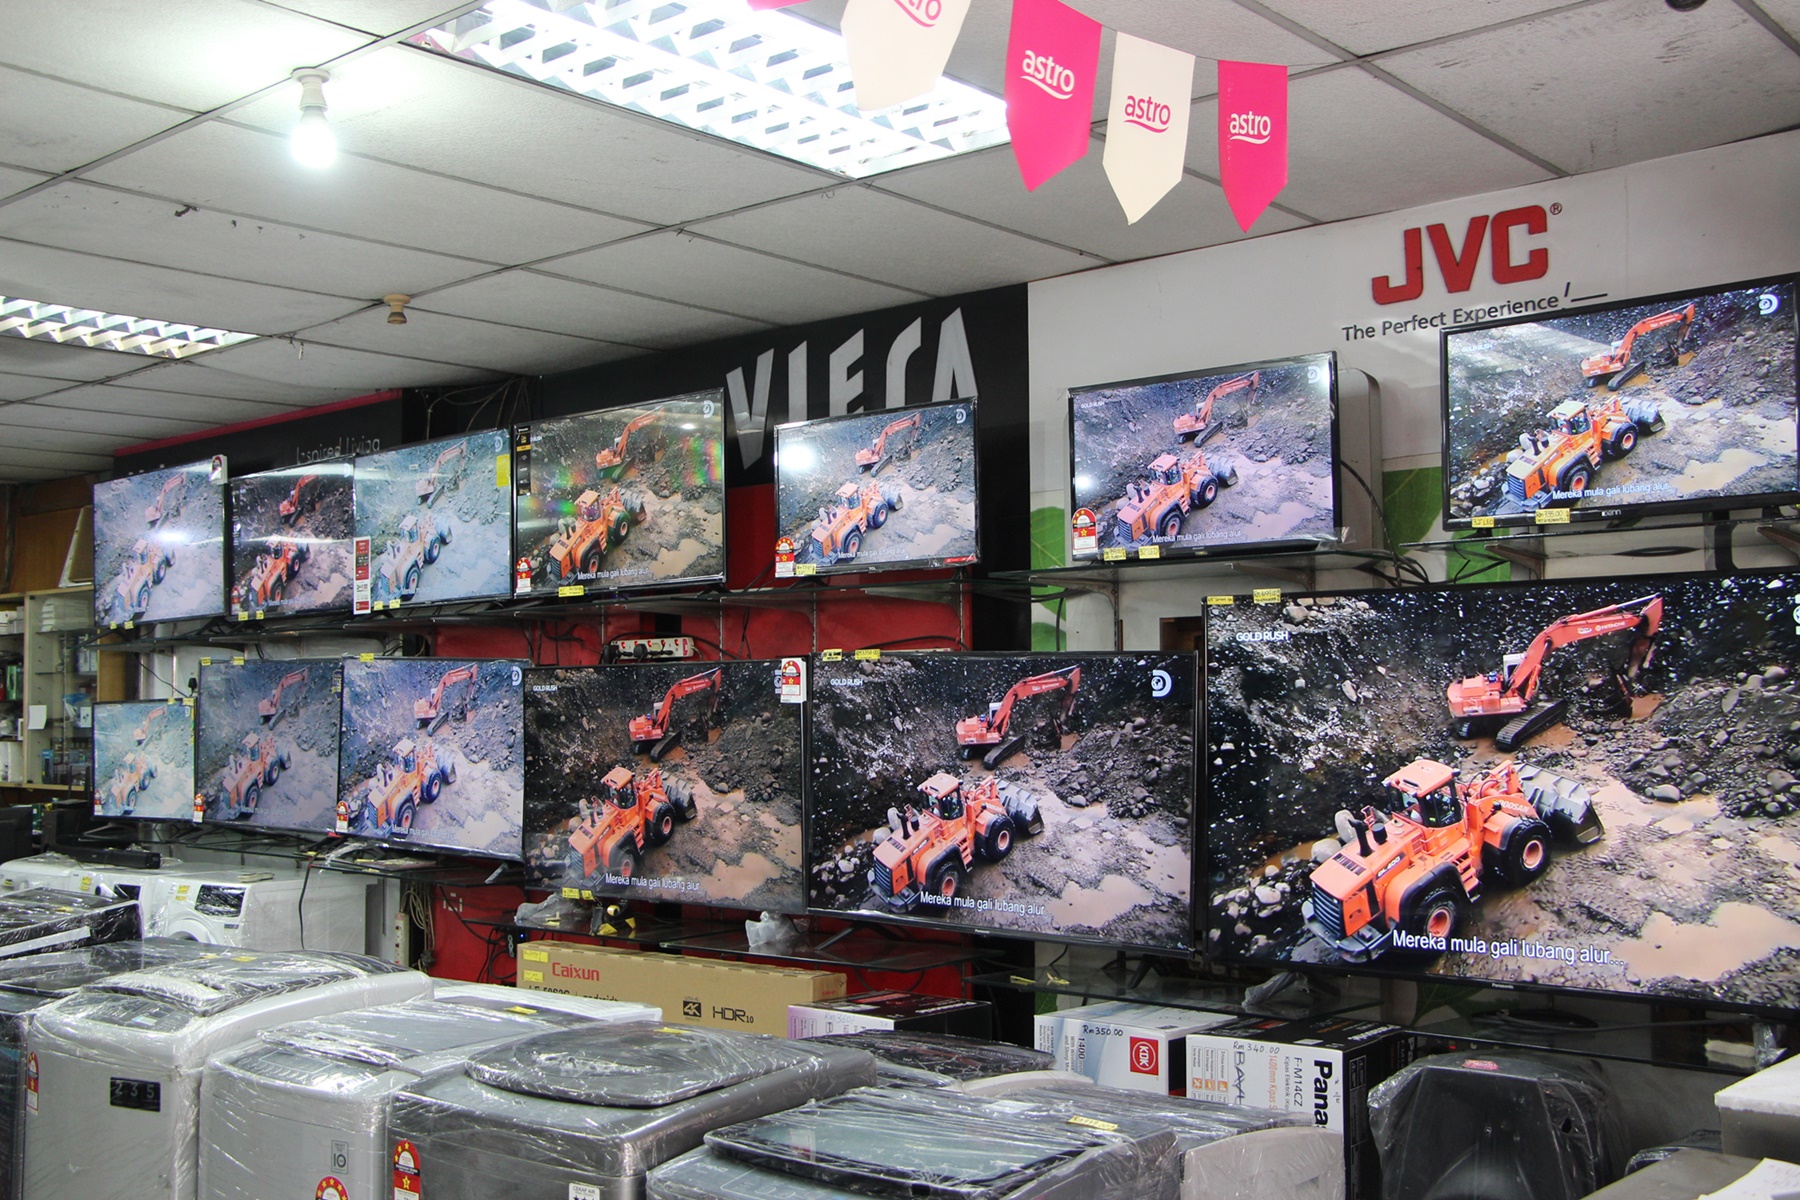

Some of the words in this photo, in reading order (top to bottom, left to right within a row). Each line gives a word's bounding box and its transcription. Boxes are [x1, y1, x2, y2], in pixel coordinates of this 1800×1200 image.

[1022, 50, 1075, 93] astro
[1125, 95, 1171, 126] astro
[1229, 111, 1271, 136] astro
[1372, 205, 1549, 306] JVC
[1342, 326, 1376, 341] The
[1382, 311, 1447, 336] Perfect
[1453, 296, 1558, 324] Experience
[1236, 632, 1262, 642] GOLD
[1263, 630, 1289, 641] RUSH
[605, 873, 630, 886] Mereka
[631, 875, 647, 887] mula
[920, 891, 952, 906] Mereka
[954, 896, 975, 909] mula
[977, 897, 993, 912] gali
[995, 900, 1025, 917] lubang
[1392, 930, 1447, 951] Mereka
[1450, 936, 1487, 954] mula
[1490, 938, 1519, 960] gali
[1521, 940, 1576, 966] lubang
[552, 962, 601, 982] Caixun
[683, 1003, 701, 1016] 4K
[1078, 1037, 1086, 1060] 1400
[1138, 1045, 1150, 1067] KDK
[1267, 1085, 1278, 1105] Kipas
[1293, 1057, 1303, 1108] F-M14CZ
[1313, 1059, 1333, 1129] Pana
